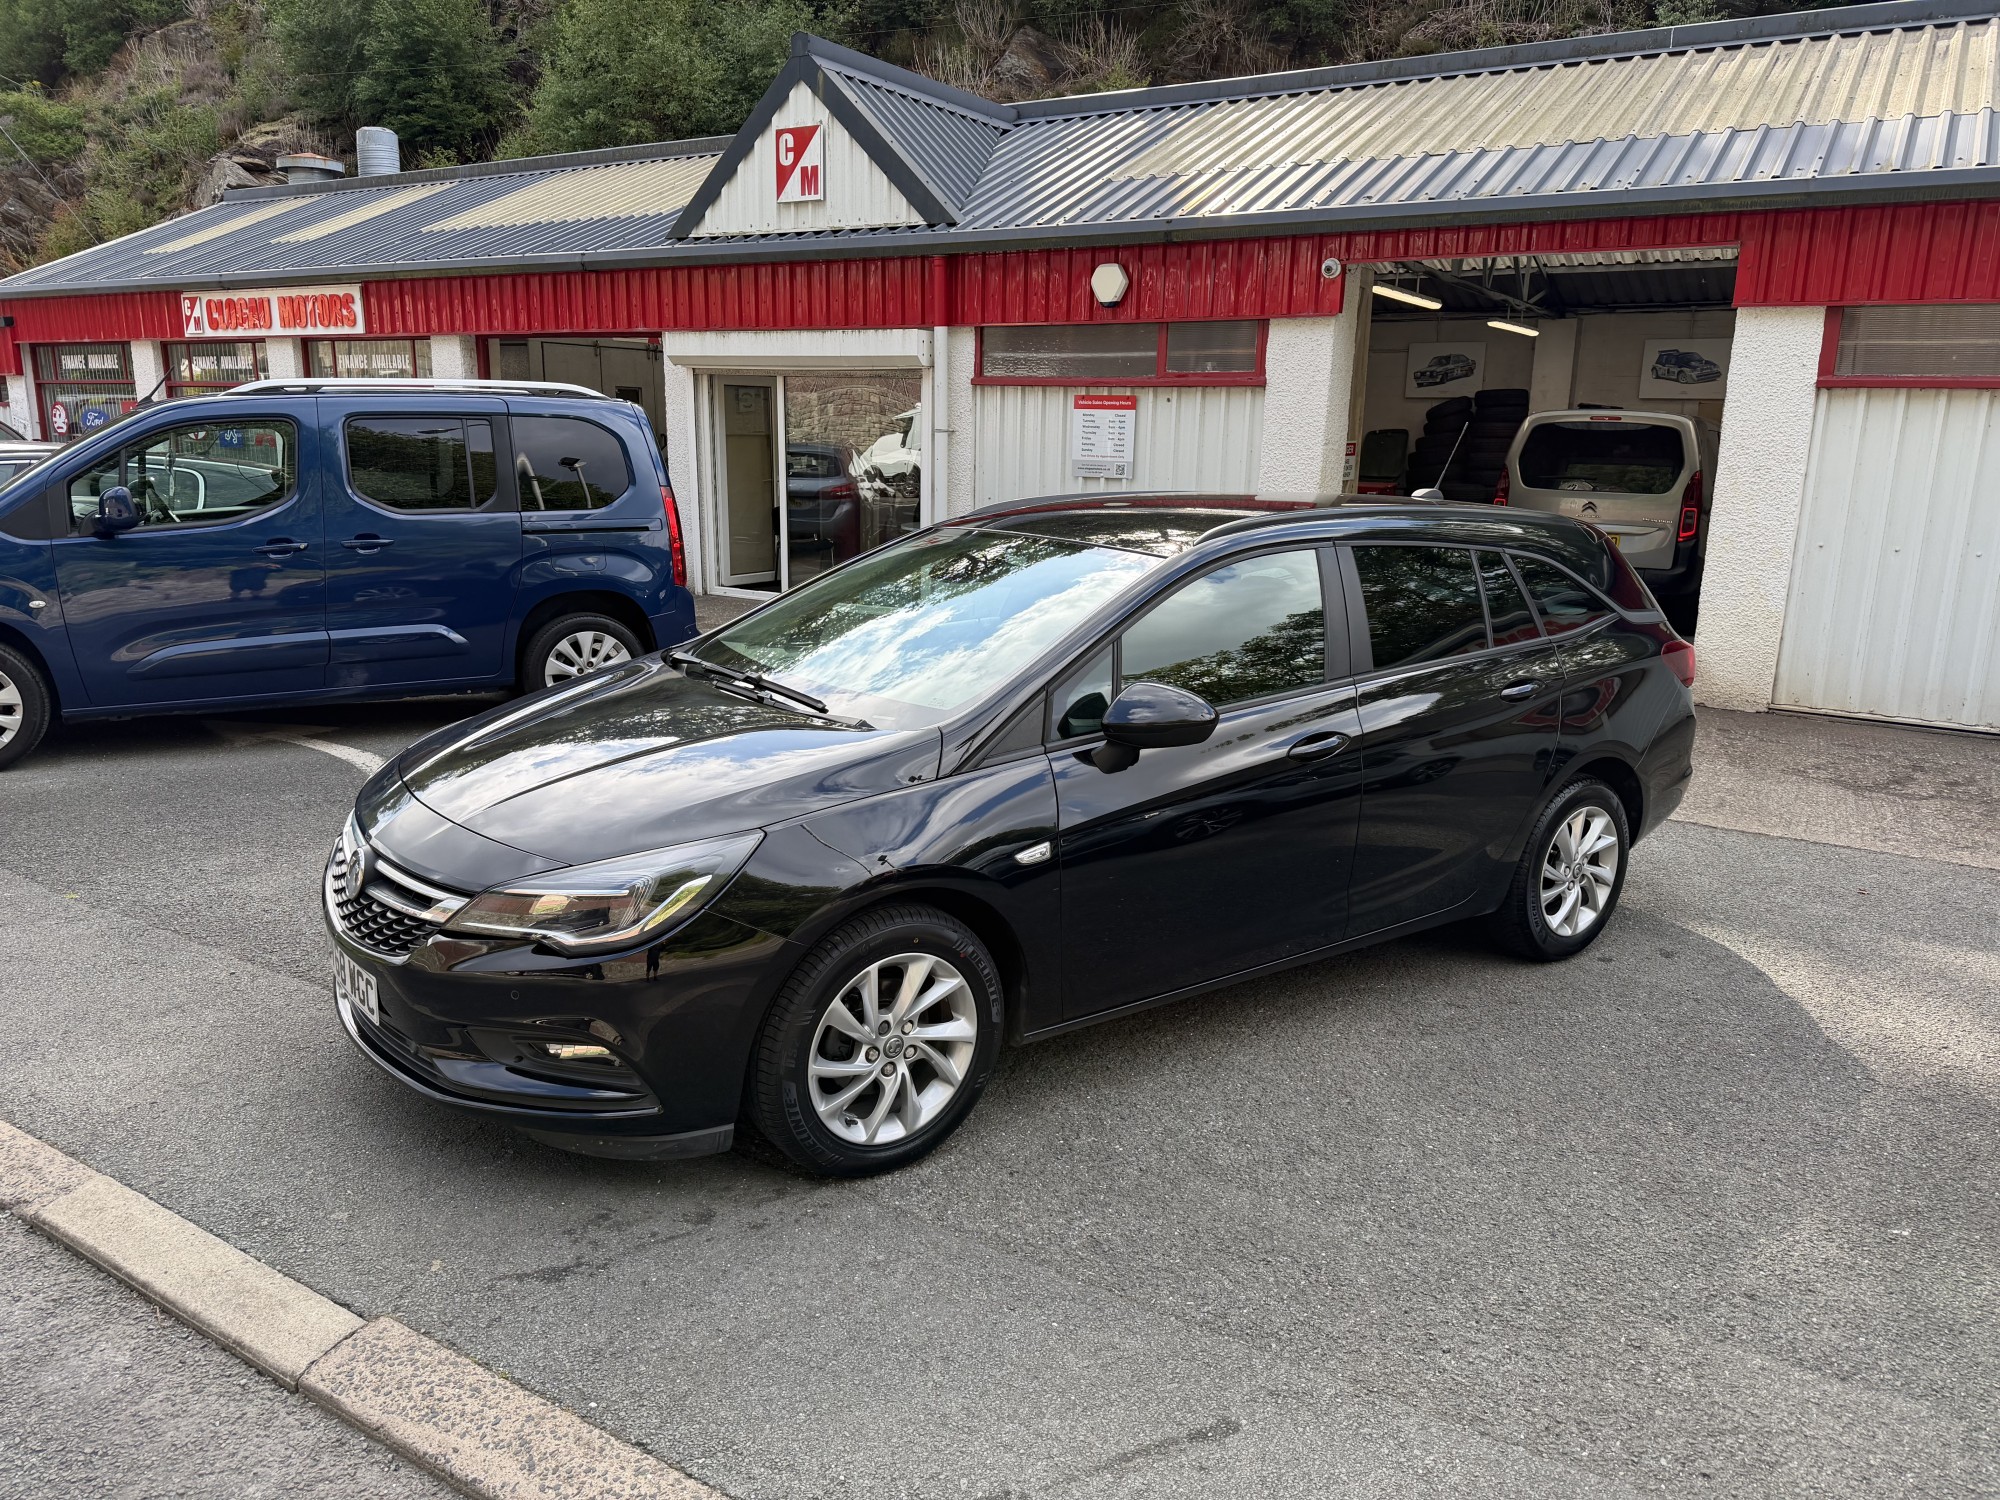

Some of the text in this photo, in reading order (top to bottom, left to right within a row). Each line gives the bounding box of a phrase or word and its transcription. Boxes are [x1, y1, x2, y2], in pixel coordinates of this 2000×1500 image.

[779, 133, 794, 166] C
[800, 165, 819, 196] M
[184, 299, 192, 316] C
[277, 293, 356, 329] MOTORS
[193, 316, 202, 332] M
[62, 354, 118, 369] FINANCE AVAILABLE
[193, 355, 253, 369] FINANCE AVAILABLE
[338, 354, 410, 369] FINANCE AVAILABLE
[86, 412, 104, 425] Ford
[347, 959, 375, 1016] WGC
